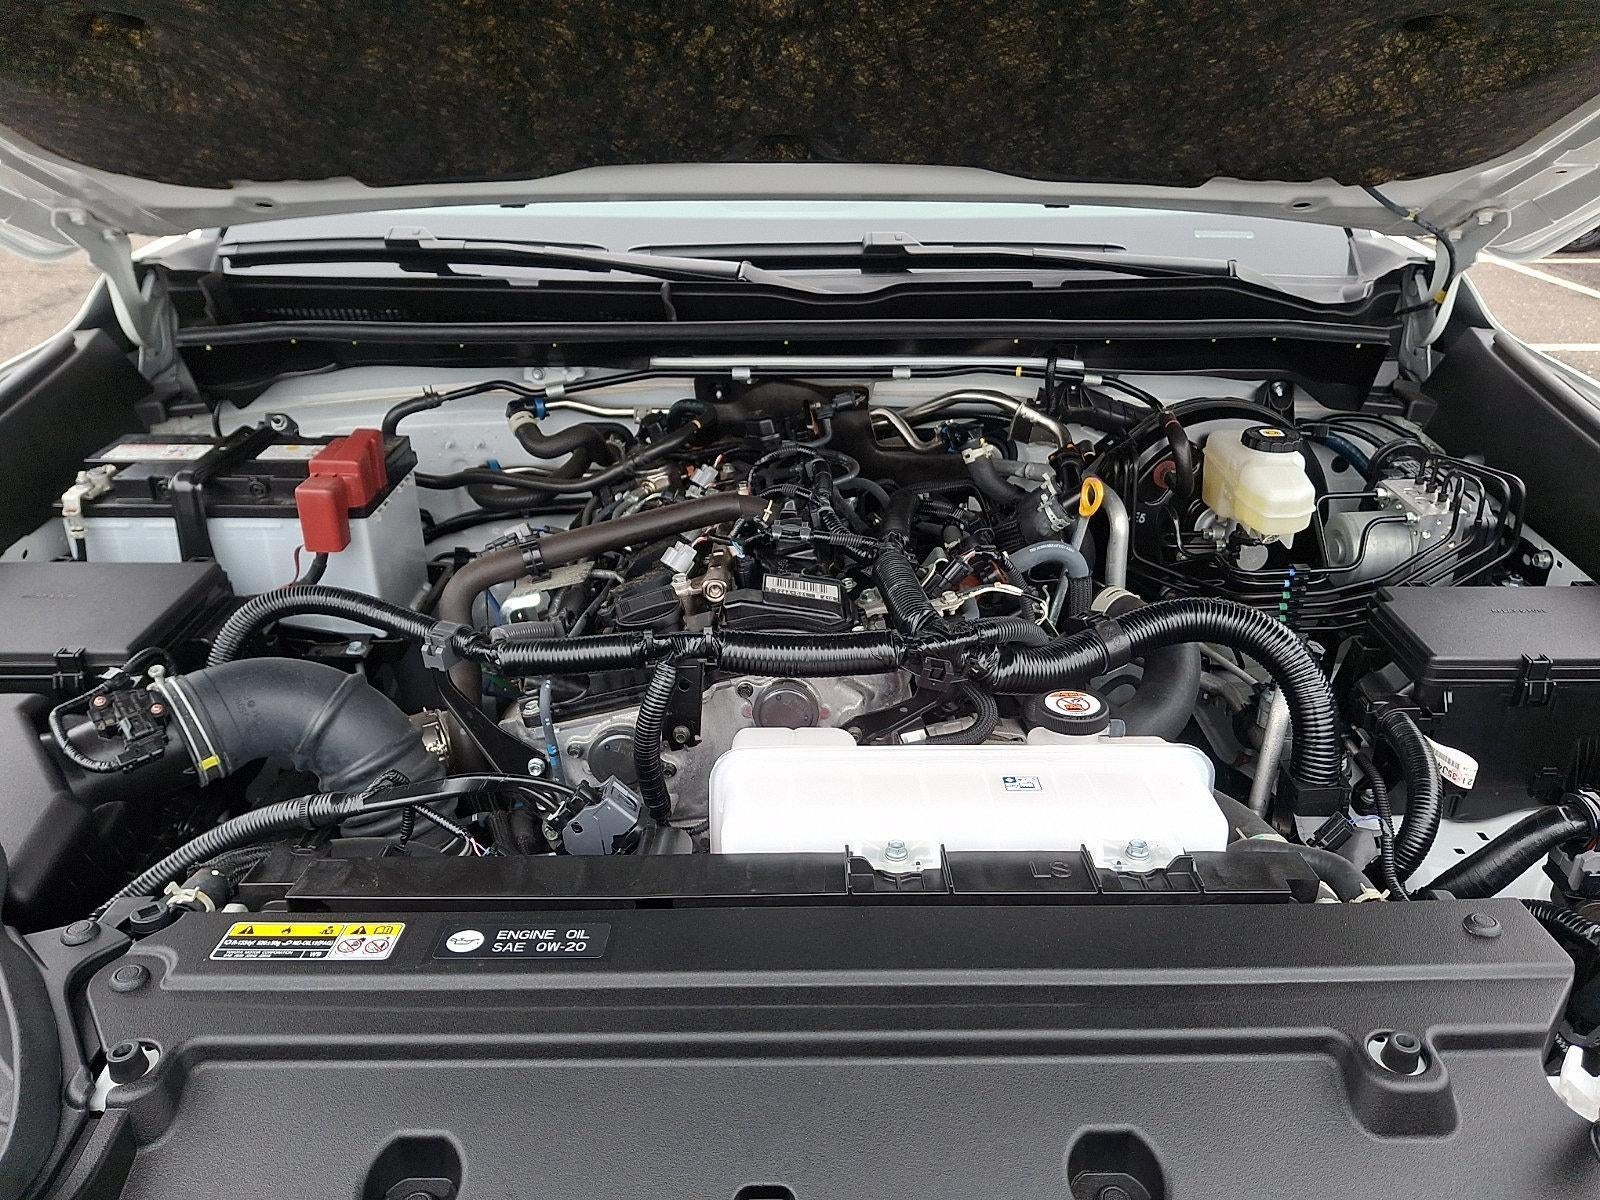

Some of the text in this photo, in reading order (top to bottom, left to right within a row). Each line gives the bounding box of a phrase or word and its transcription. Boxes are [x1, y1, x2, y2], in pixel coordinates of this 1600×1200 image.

[1029, 861, 1072, 879] LS
[496, 929, 590, 940] ENGINE OIL
[491, 941, 587, 952] SAE 0W-20
